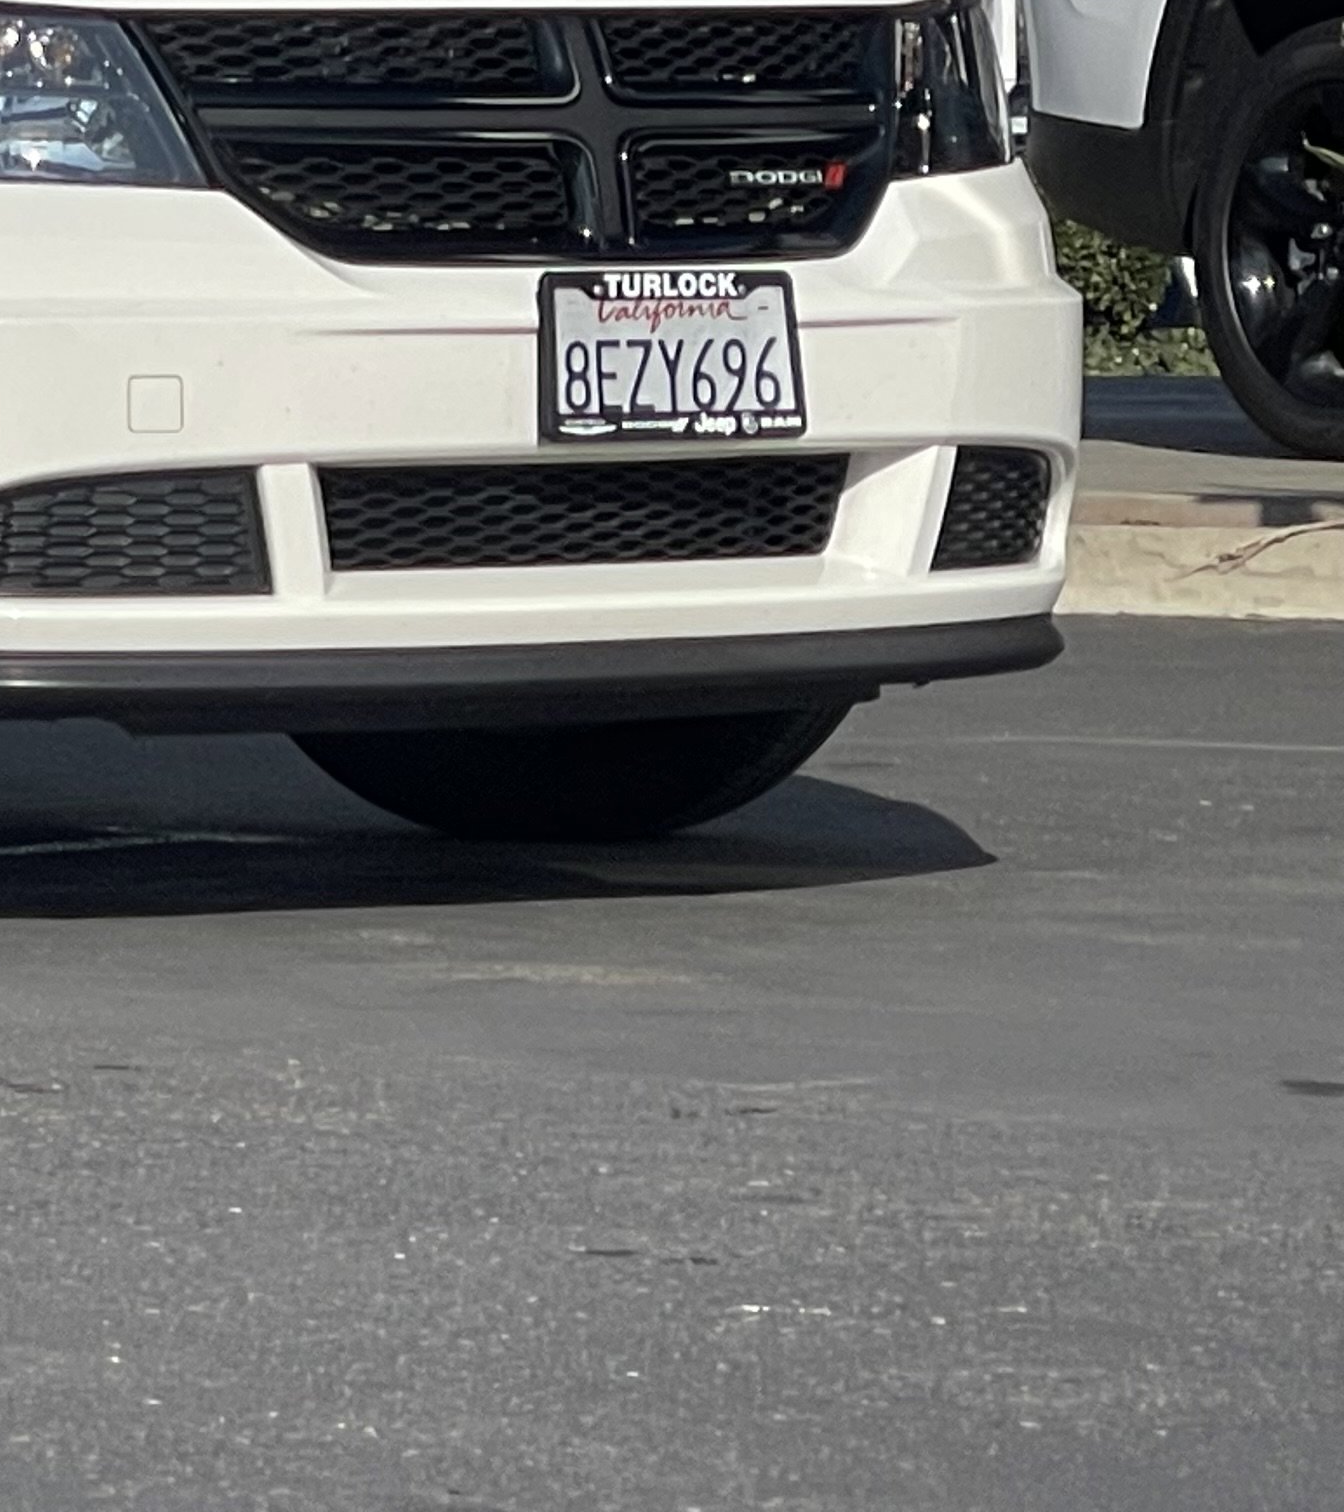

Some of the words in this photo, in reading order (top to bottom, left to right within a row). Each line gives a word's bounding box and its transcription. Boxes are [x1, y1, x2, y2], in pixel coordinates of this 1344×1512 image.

[604, 273, 738, 298] TURLOCK
[598, 298, 747, 334] California
[565, 337, 782, 414] 8EZY696
[694, 412, 737, 436] Jeep
